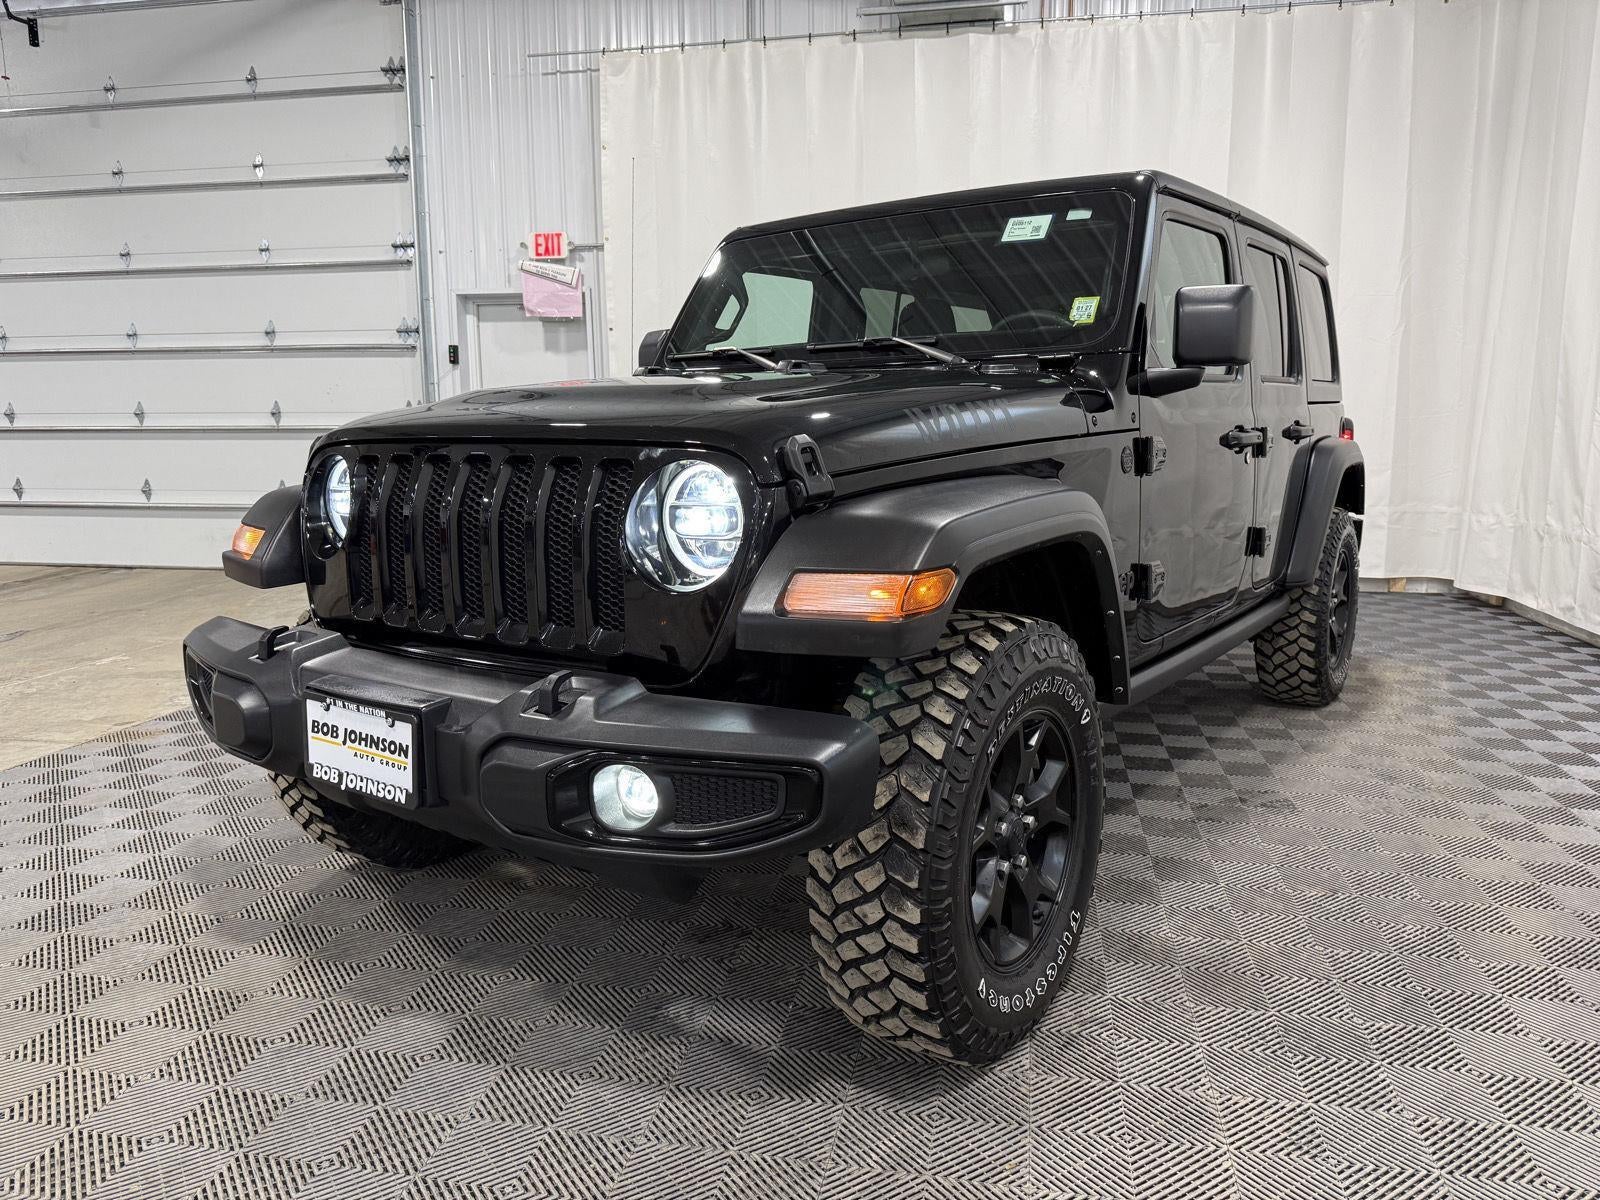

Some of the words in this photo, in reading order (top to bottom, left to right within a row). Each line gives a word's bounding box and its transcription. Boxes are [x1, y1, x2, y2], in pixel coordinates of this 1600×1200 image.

[535, 233, 562, 257] EXIT
[336, 700, 343, 709] IN
[344, 702, 358, 712] THE
[360, 705, 386, 718] NATION
[311, 720, 340, 739] BOB
[342, 728, 410, 760] JOHNSON
[353, 752, 375, 763] AUTO
[380, 759, 408, 772] GROUP
[313, 763, 339, 784] BOB
[341, 771, 407, 805] JOHNSON
